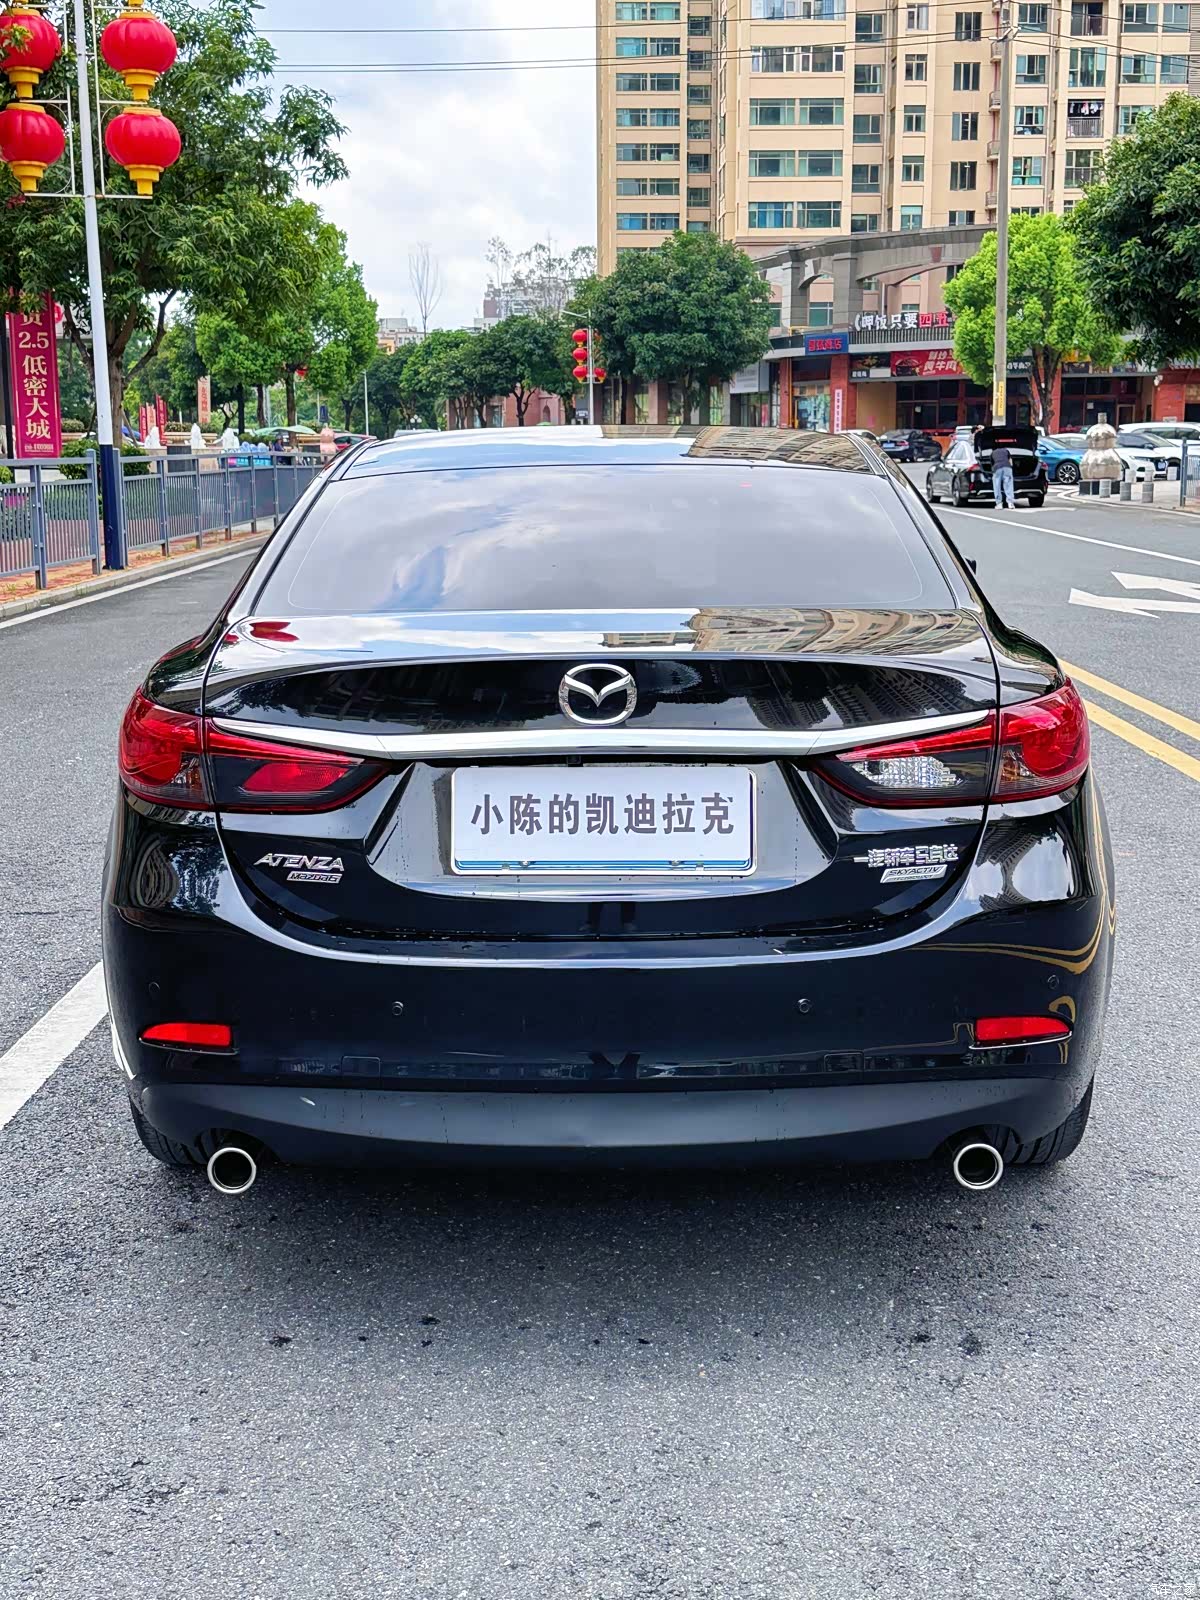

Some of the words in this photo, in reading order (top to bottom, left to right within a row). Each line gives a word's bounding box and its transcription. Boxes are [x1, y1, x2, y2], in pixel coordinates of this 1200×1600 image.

[470, 792, 735, 836] 小陈的凯迪拉克
[253, 853, 345, 871] ATENZA
[853, 844, 959, 868] 一汽轿车马自达
[888, 866, 941, 876] SKYACTIV
